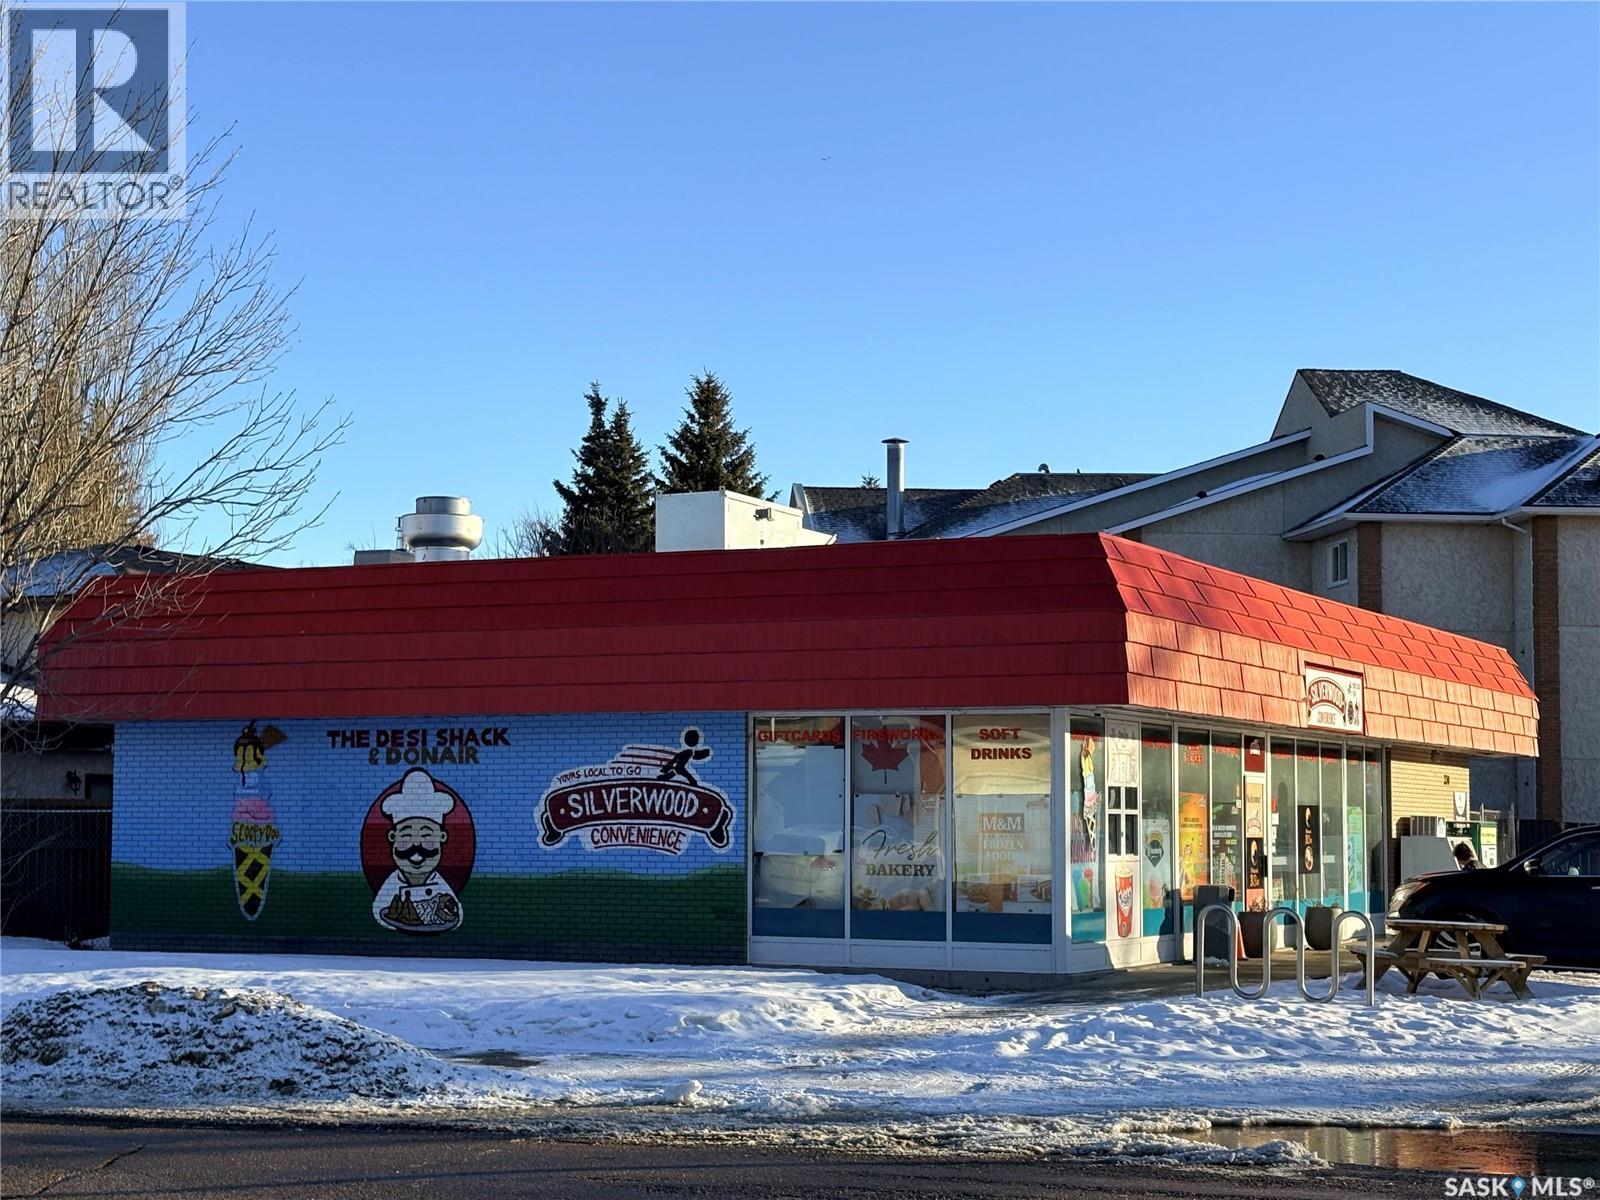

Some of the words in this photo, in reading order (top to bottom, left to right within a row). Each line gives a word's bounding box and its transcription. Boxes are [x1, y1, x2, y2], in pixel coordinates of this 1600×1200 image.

[327, 729, 370, 749] THE
[376, 728, 428, 748] DESI
[436, 727, 512, 747] SHACK
[853, 728, 945, 742] FIREWORKS
[979, 727, 1022, 741] SOFT
[385, 747, 480, 765] DONAIR
[970, 747, 1033, 760] DRINKS
[583, 767, 609, 778] LOCAL
[609, 766, 624, 776] TO
[626, 765, 642, 776] GO
[567, 787, 699, 818] SILVERWOOD
[982, 816, 1022, 831] M&M
[590, 825, 687, 849] CONVENIENCE
[862, 828, 938, 861] Fresh
[865, 864, 936, 877] BAKERY
